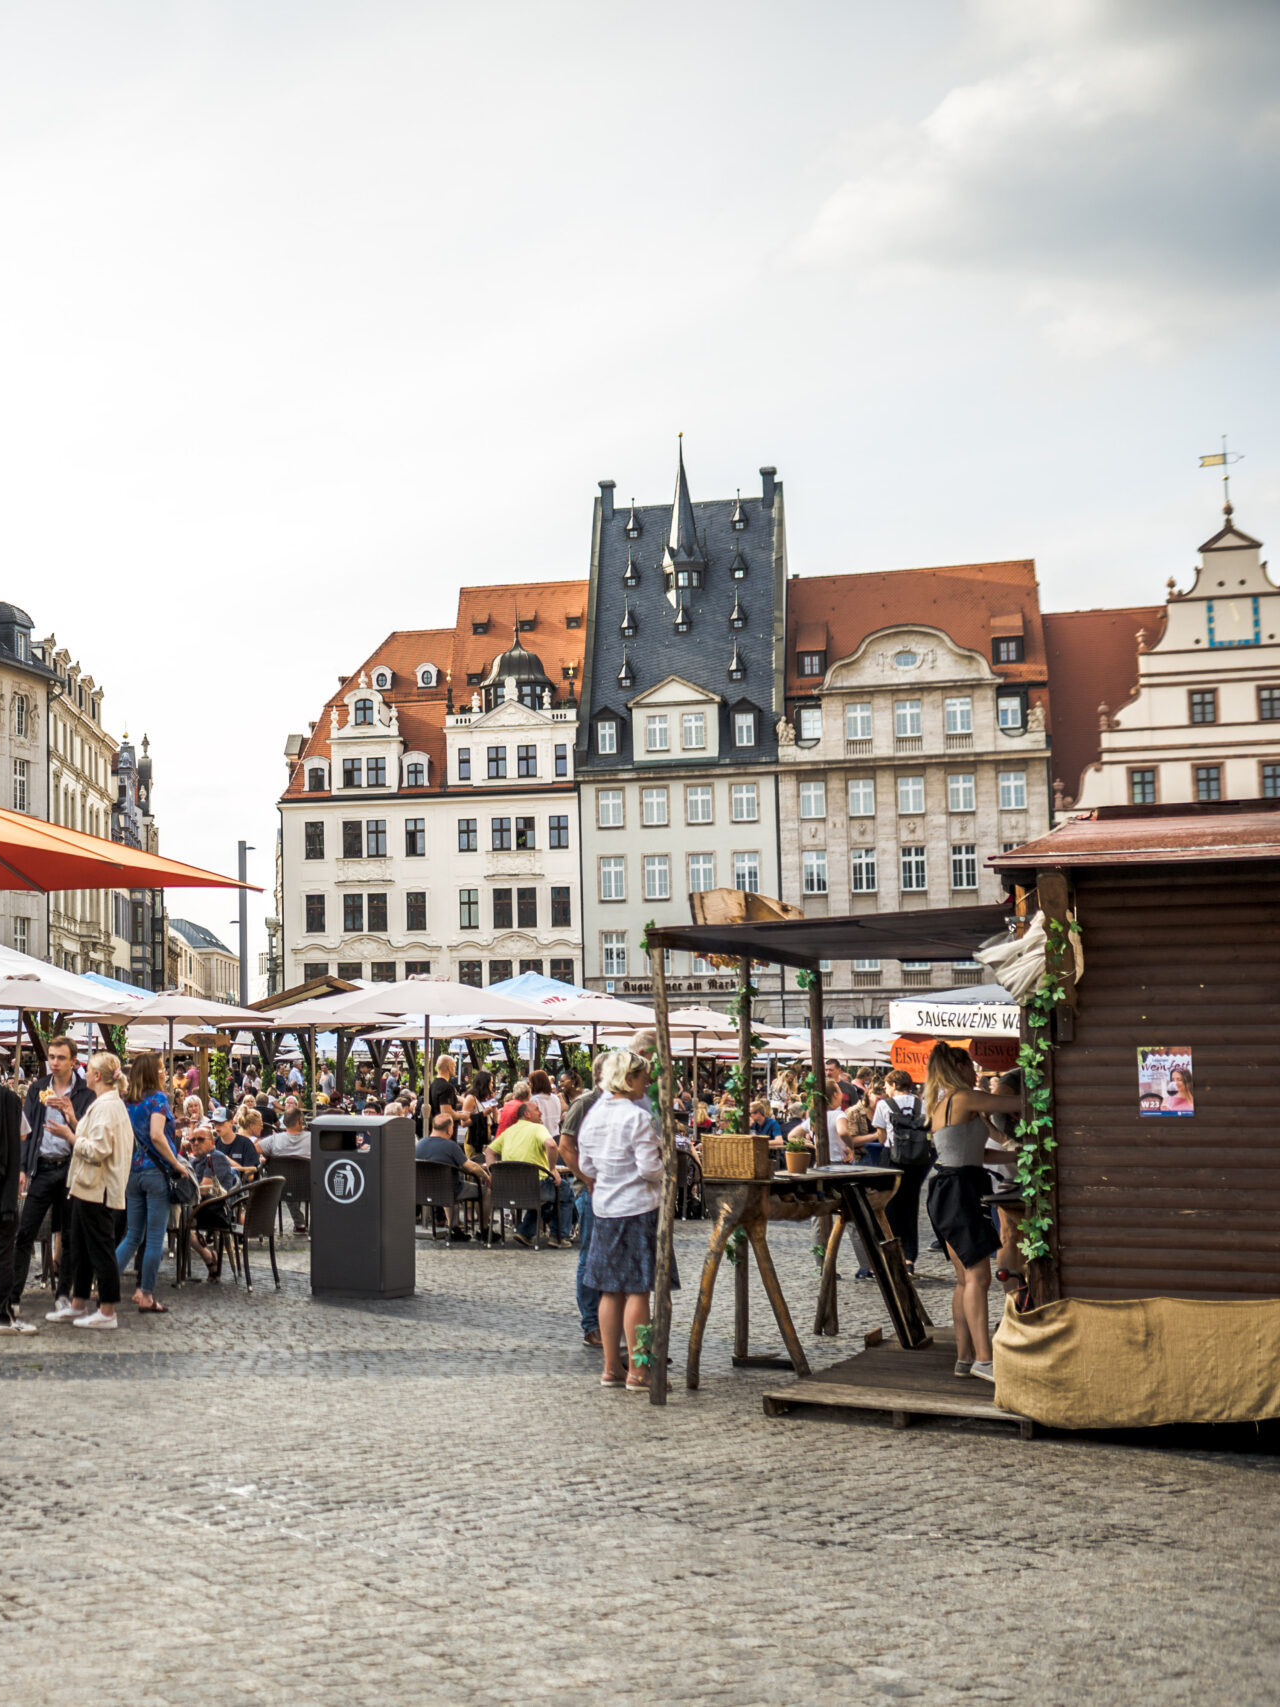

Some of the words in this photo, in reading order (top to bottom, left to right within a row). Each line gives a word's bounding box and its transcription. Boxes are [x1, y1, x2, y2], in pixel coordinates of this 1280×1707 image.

[623, 980, 682, 993] Auguner
[687, 982, 702, 991] am
[707, 978, 739, 991] Mark
[916, 1010, 998, 1029] SAUERWEINS
[1003, 1012, 1020, 1029] WE
[895, 1046, 929, 1066] Eiswe
[974, 1040, 1020, 1057] Eiswei
